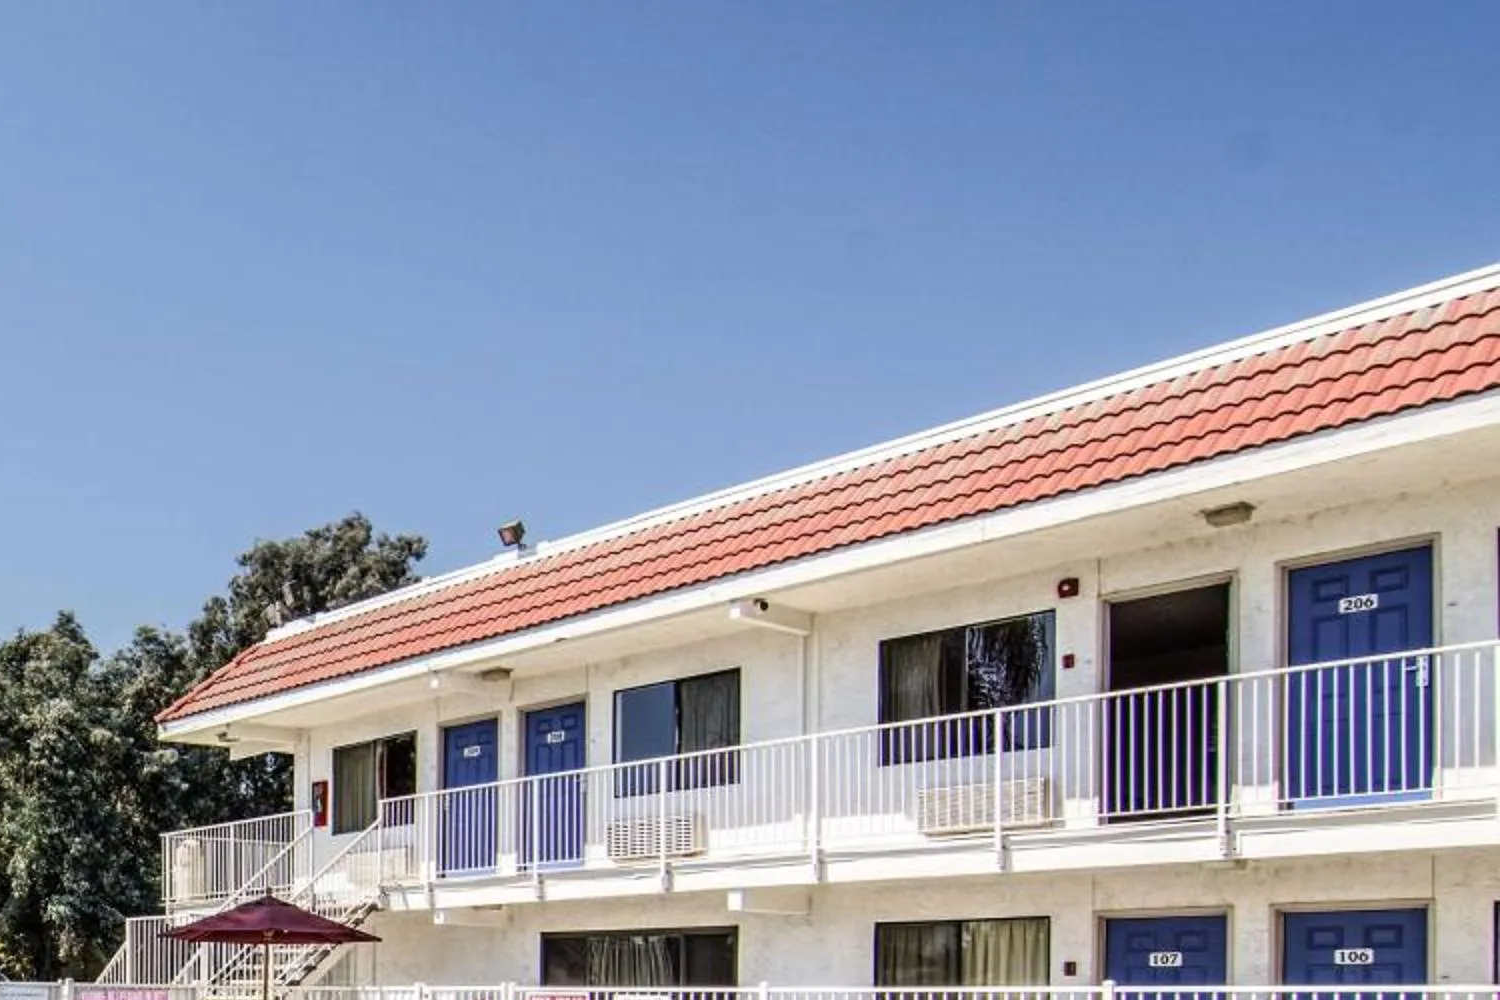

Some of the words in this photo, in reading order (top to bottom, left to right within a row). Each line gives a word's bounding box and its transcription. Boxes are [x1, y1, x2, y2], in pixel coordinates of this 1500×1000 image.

[1343, 596, 1375, 611] 206
[1152, 953, 1179, 966] 107
[1338, 950, 1370, 963] 106
